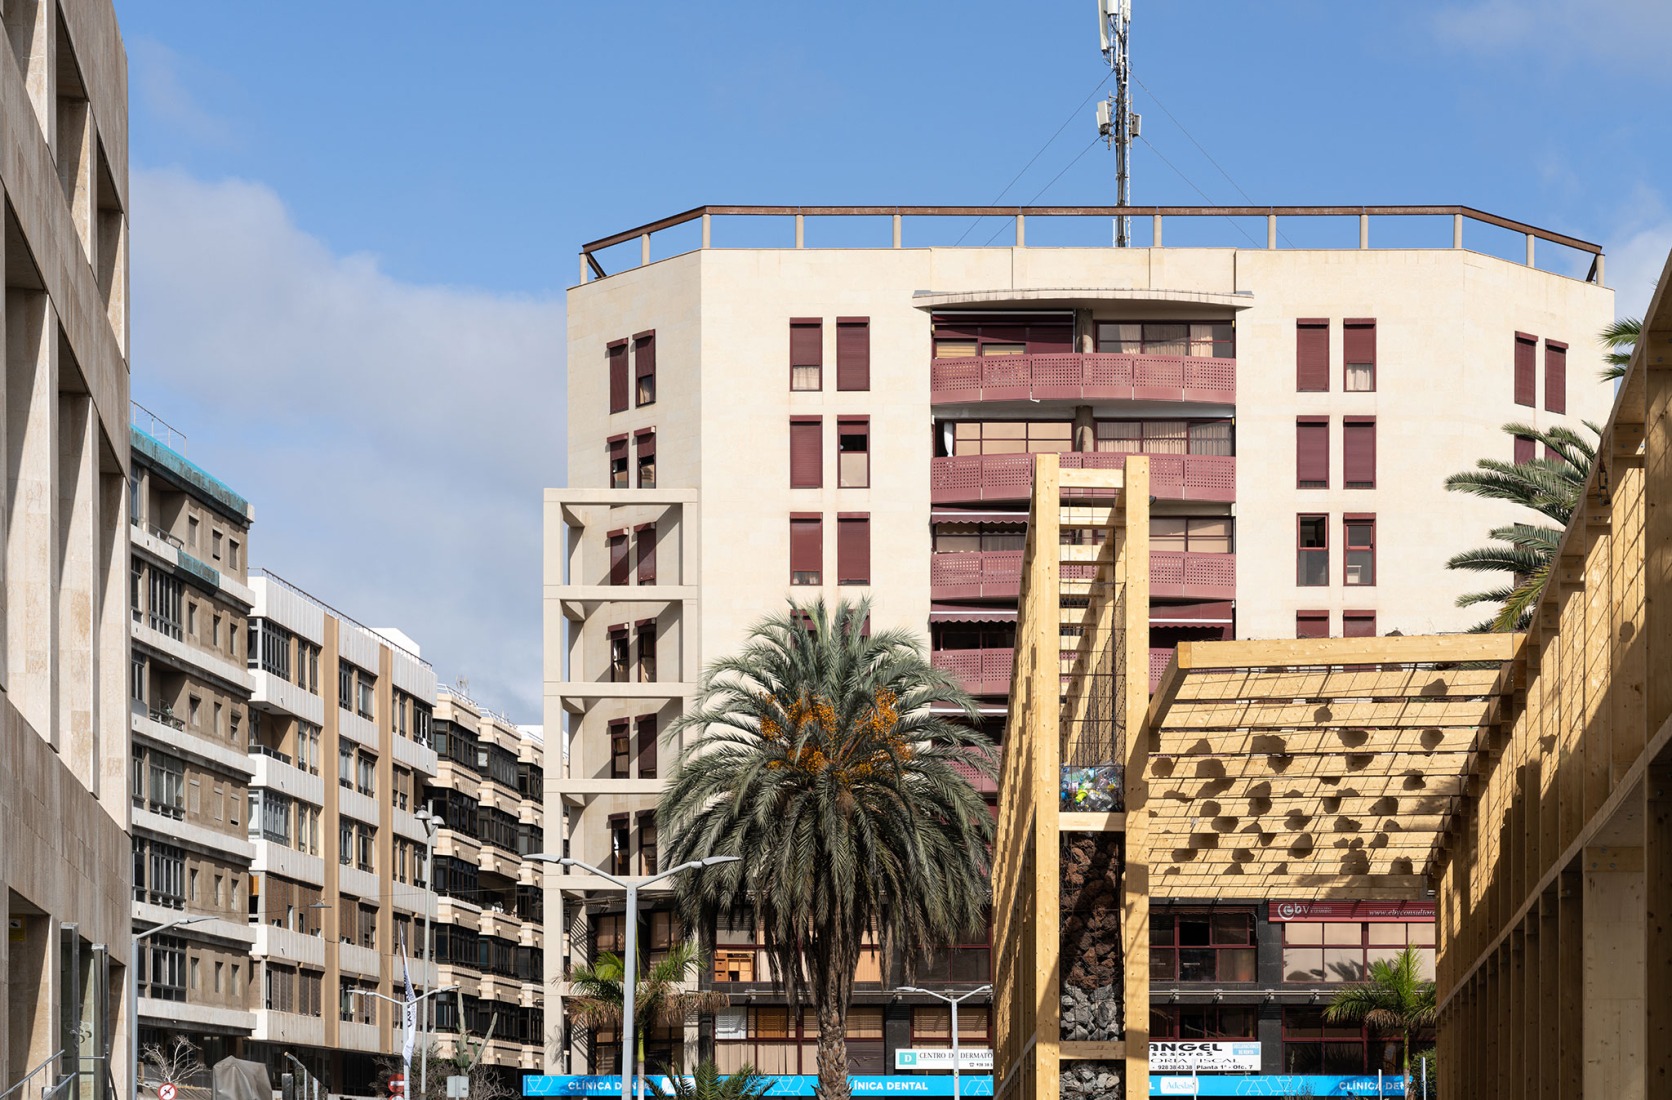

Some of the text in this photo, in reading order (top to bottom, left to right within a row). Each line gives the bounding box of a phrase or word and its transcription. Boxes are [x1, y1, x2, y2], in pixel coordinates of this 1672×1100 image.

[568, 1080, 611, 1090] CLÍNICA
[853, 1080, 928, 1090] ÍNICA DENTAL
[1339, 1080, 1381, 1090] CLÍNICA
